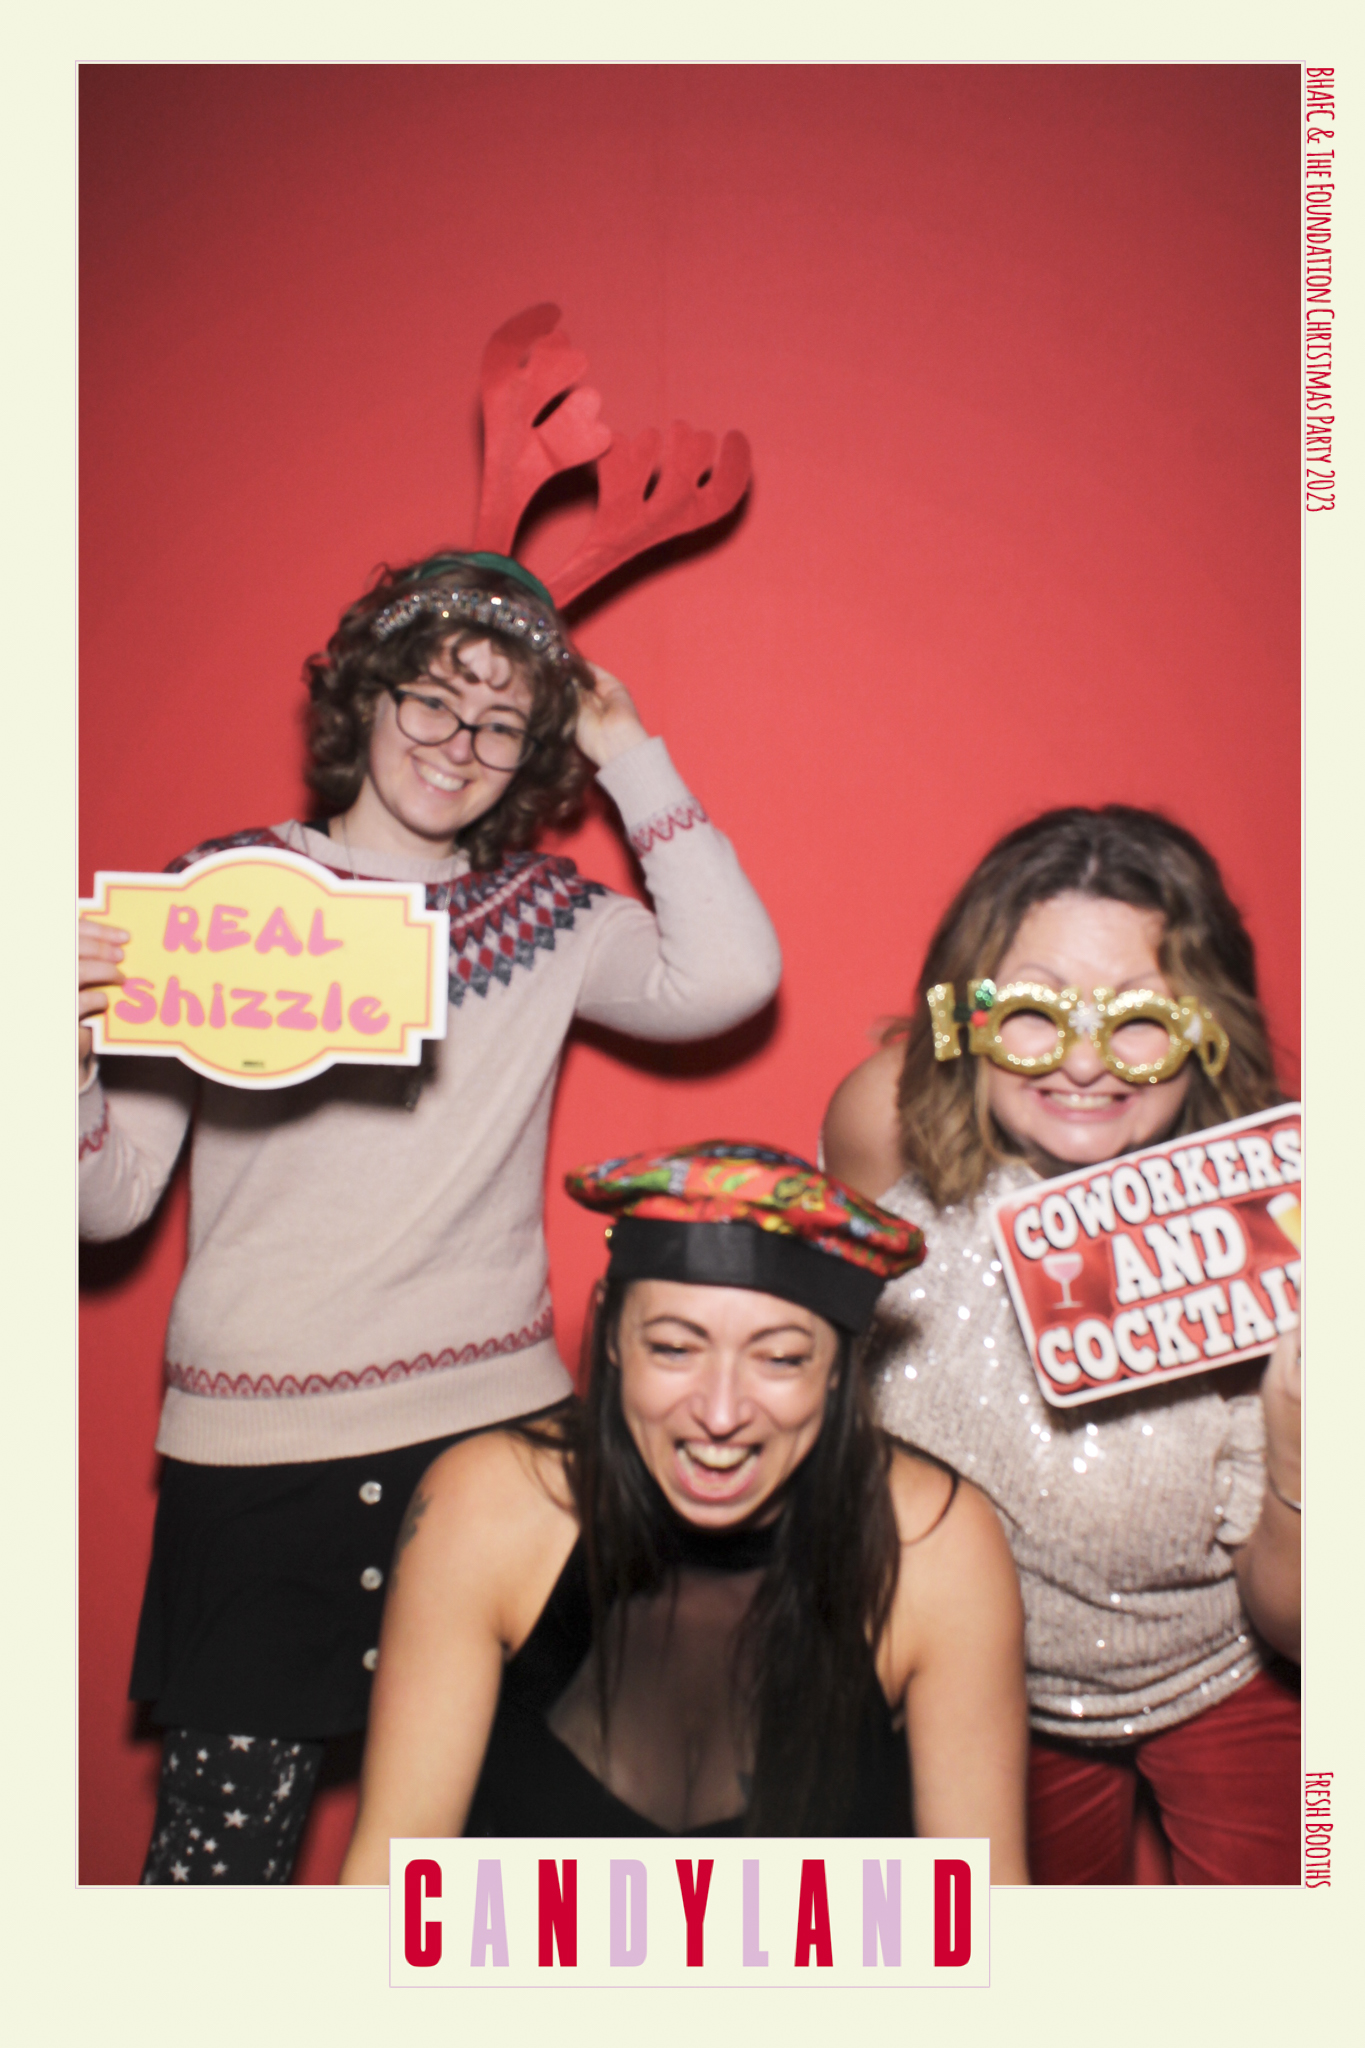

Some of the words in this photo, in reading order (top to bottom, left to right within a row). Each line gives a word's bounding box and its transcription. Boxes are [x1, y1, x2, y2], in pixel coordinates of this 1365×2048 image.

[162, 904, 343, 956] REAL
[1014, 1128, 1301, 1260] COWORKERS
[1111, 1206, 1248, 1304] AND
